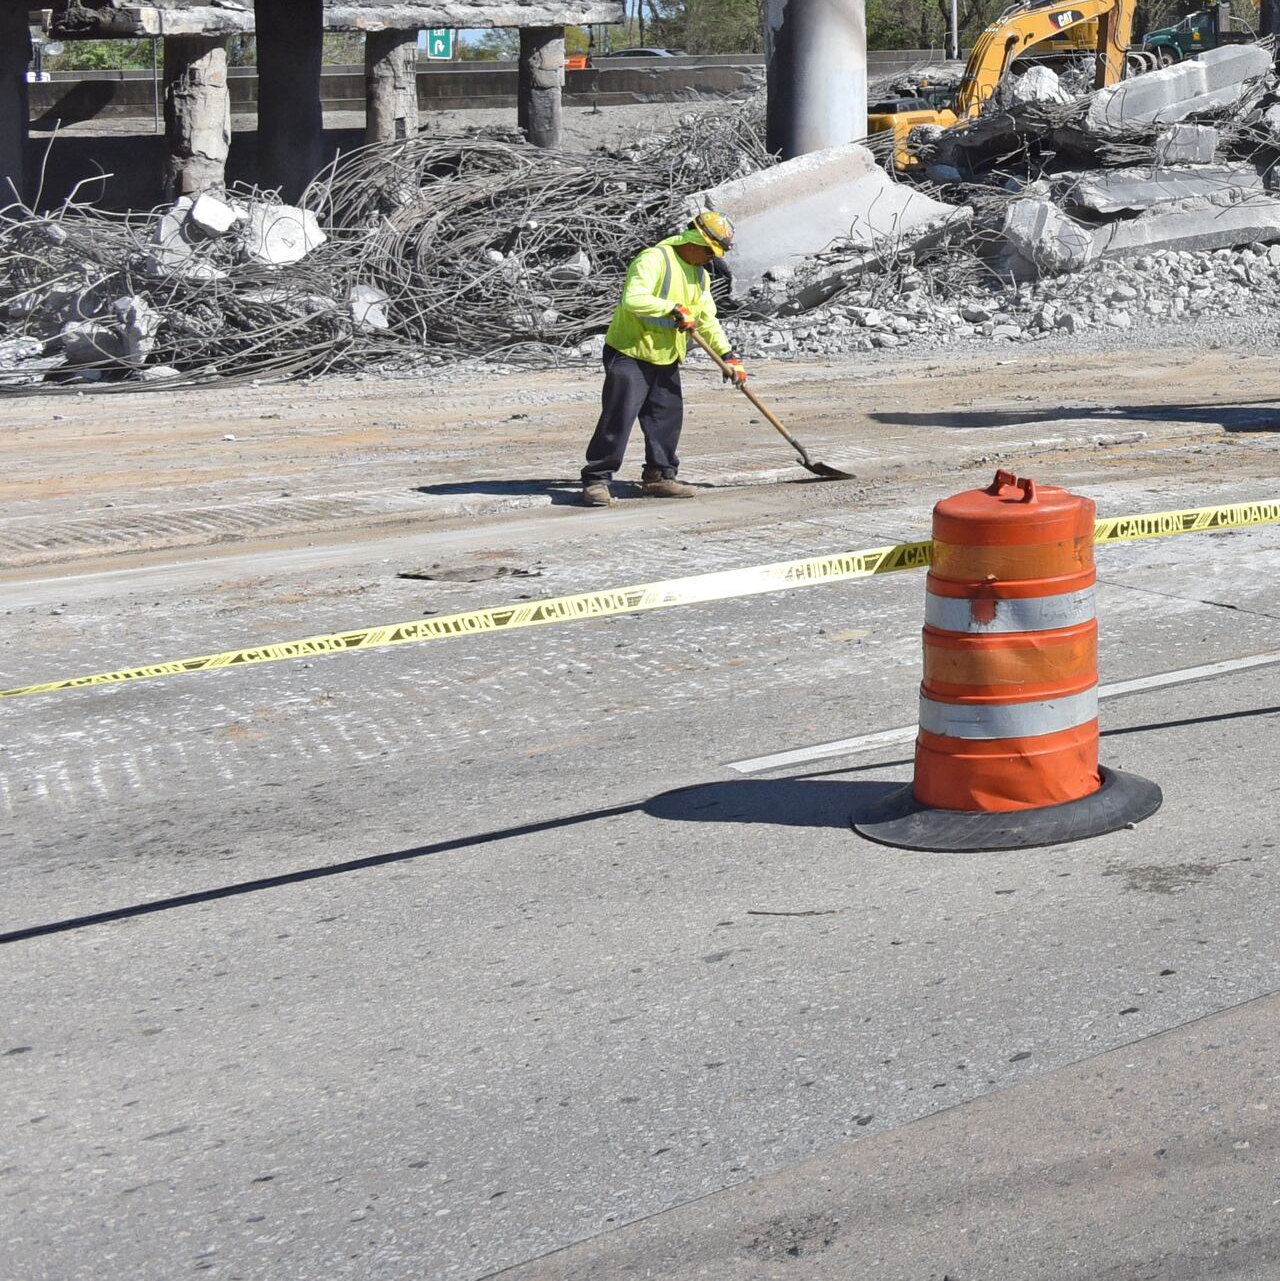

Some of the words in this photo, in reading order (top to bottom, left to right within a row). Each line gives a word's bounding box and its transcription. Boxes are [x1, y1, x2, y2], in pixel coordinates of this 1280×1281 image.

[1058, 10, 1073, 27] CAT
[1117, 515, 1184, 537] CAUTION
[1217, 504, 1280, 526] CUIDADO
[243, 636, 347, 662] CUIDADO
[399, 614, 494, 640] CAUTION
[542, 591, 628, 619] CUIDADO
[794, 556, 865, 580] CUIDADO
